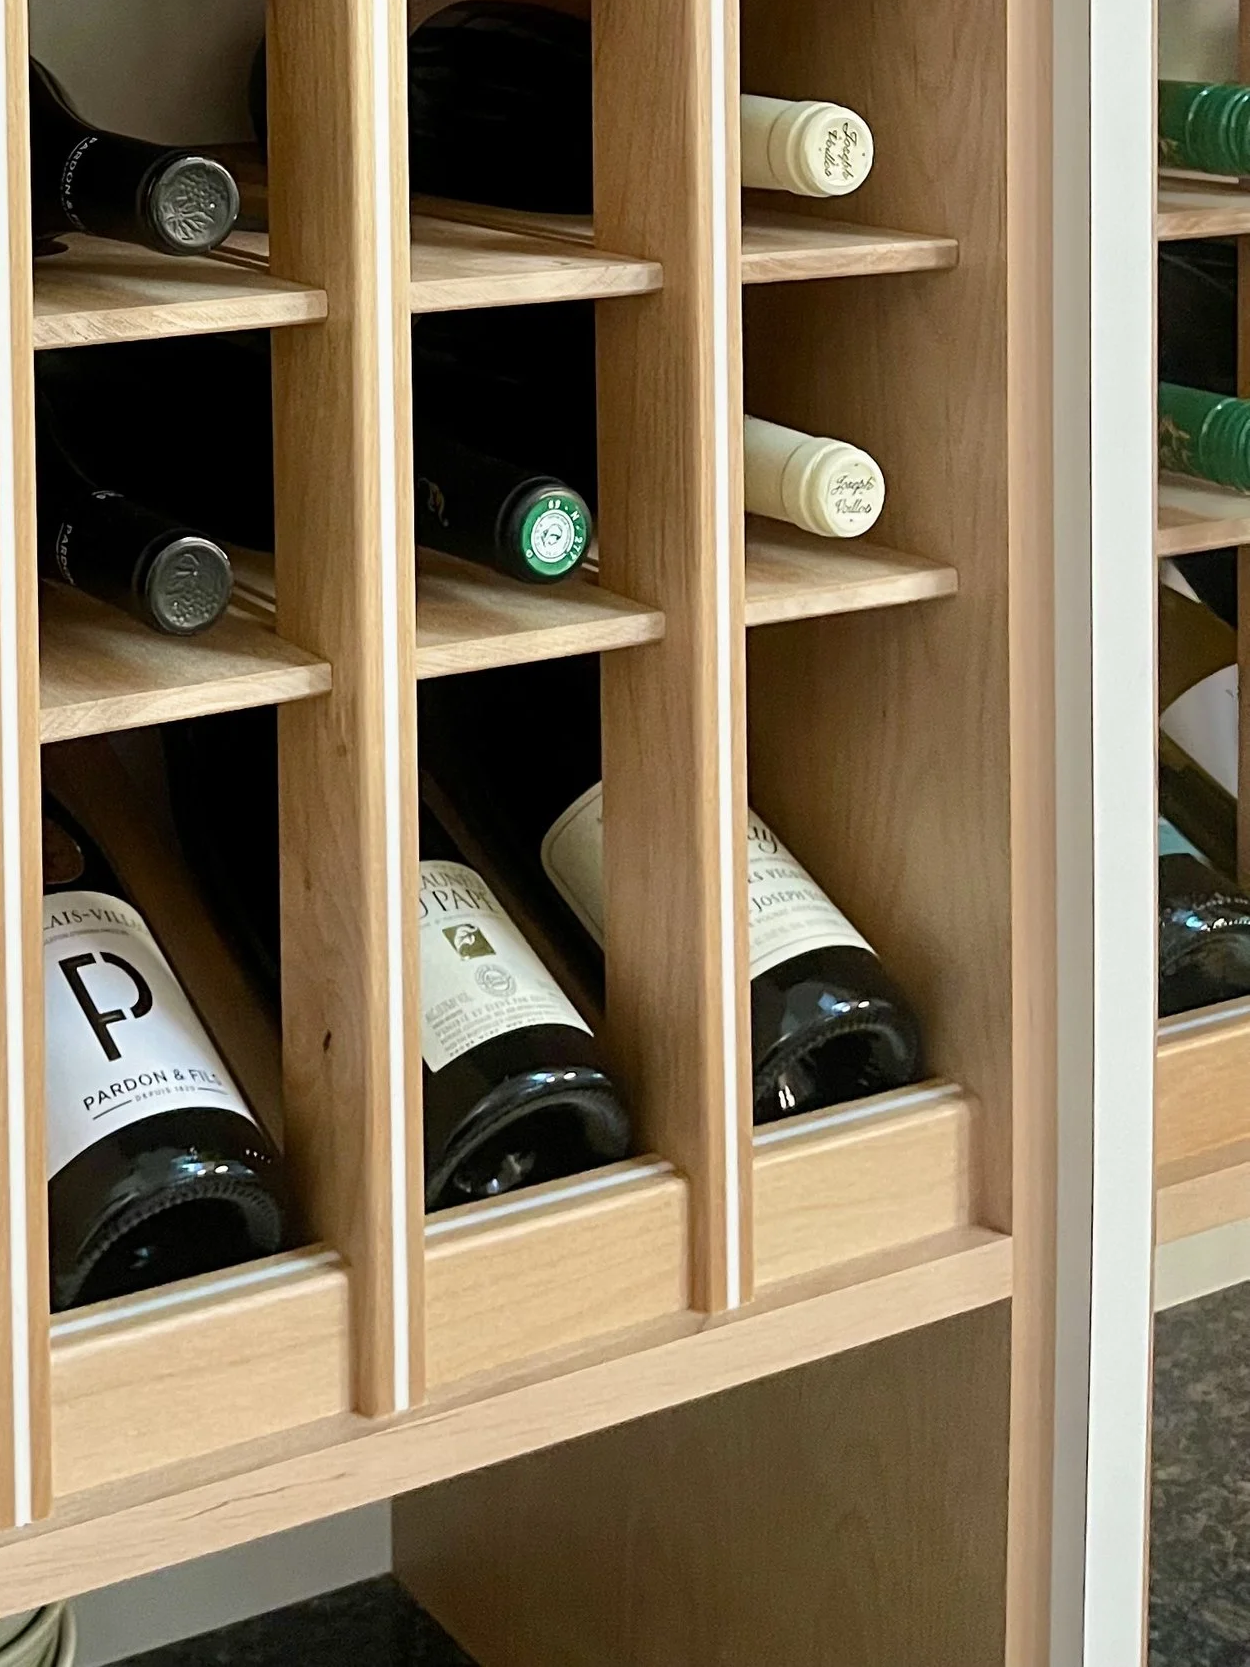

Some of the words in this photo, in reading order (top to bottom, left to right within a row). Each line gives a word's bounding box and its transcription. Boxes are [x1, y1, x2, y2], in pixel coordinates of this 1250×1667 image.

[64, 137, 98, 195] PARDON
[58, 951, 154, 1063] P
[82, 1069, 168, 1111] PARDON
[173, 1068, 185, 1081] &
